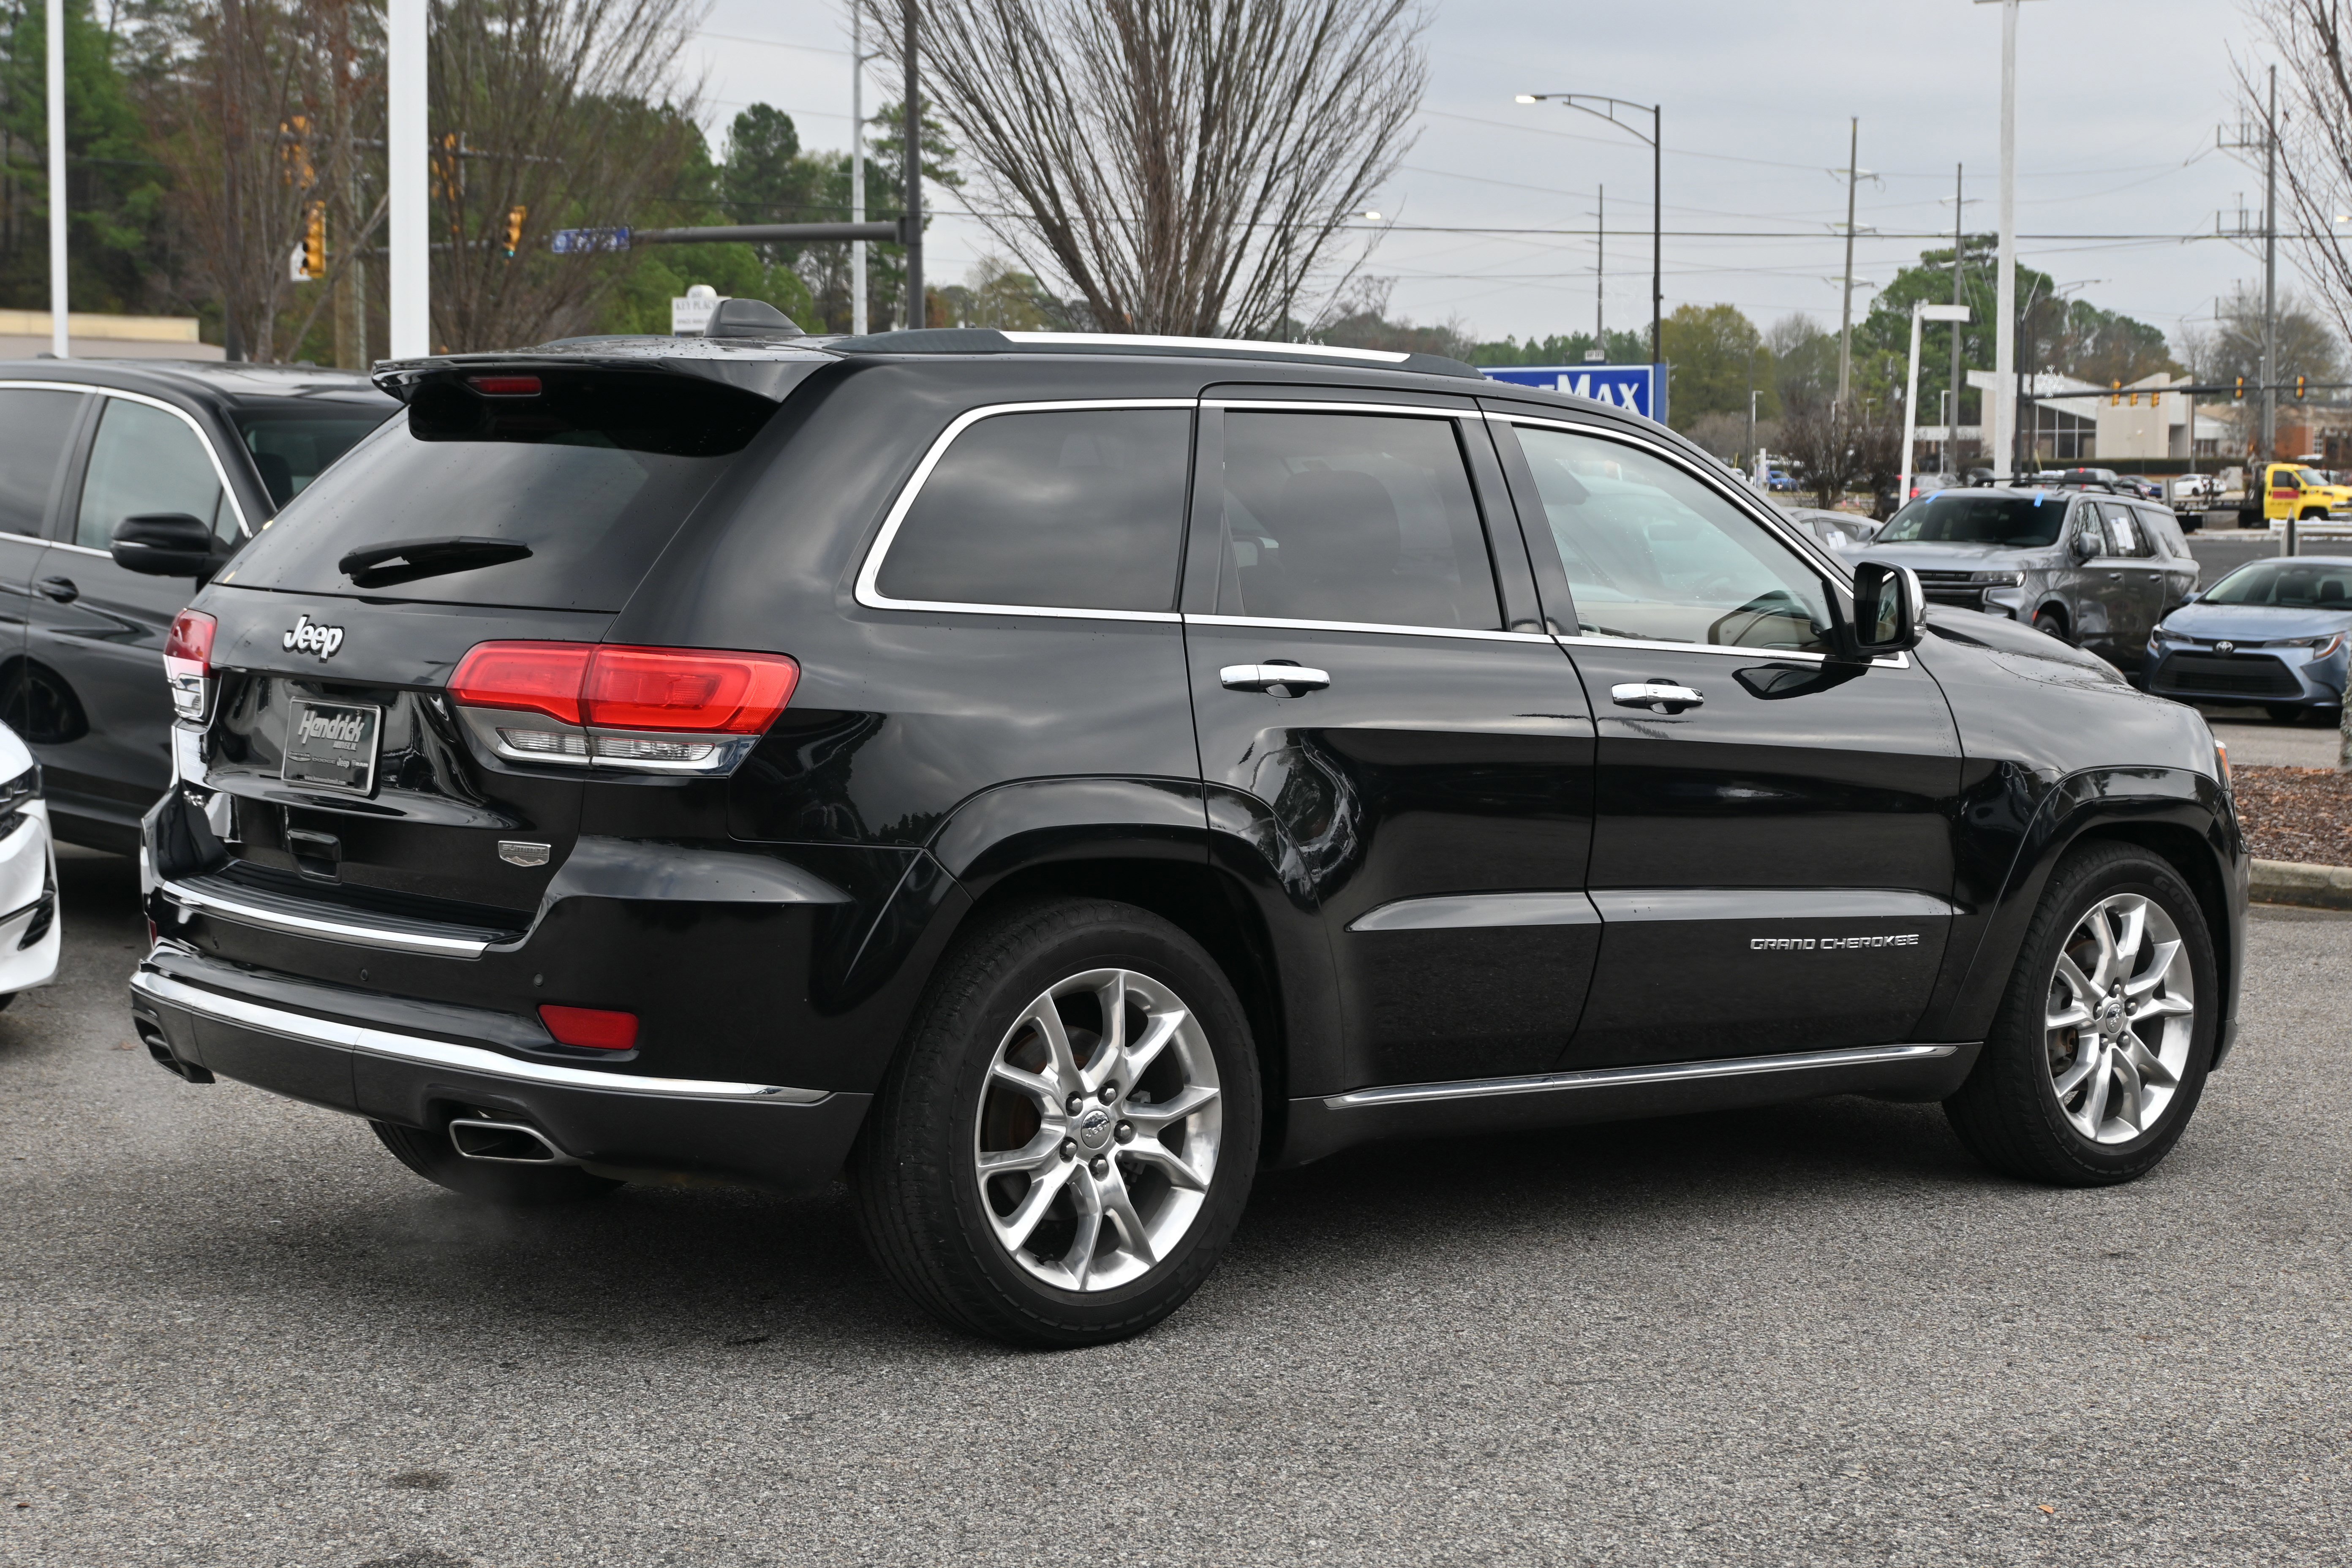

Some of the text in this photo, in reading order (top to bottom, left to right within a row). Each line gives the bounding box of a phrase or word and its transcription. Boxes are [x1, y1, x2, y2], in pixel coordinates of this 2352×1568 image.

[283, 615, 345, 663] Jeep
[298, 710, 364, 744] Hendrick
[1750, 934, 1919, 950] GRAND CHEROKEE
